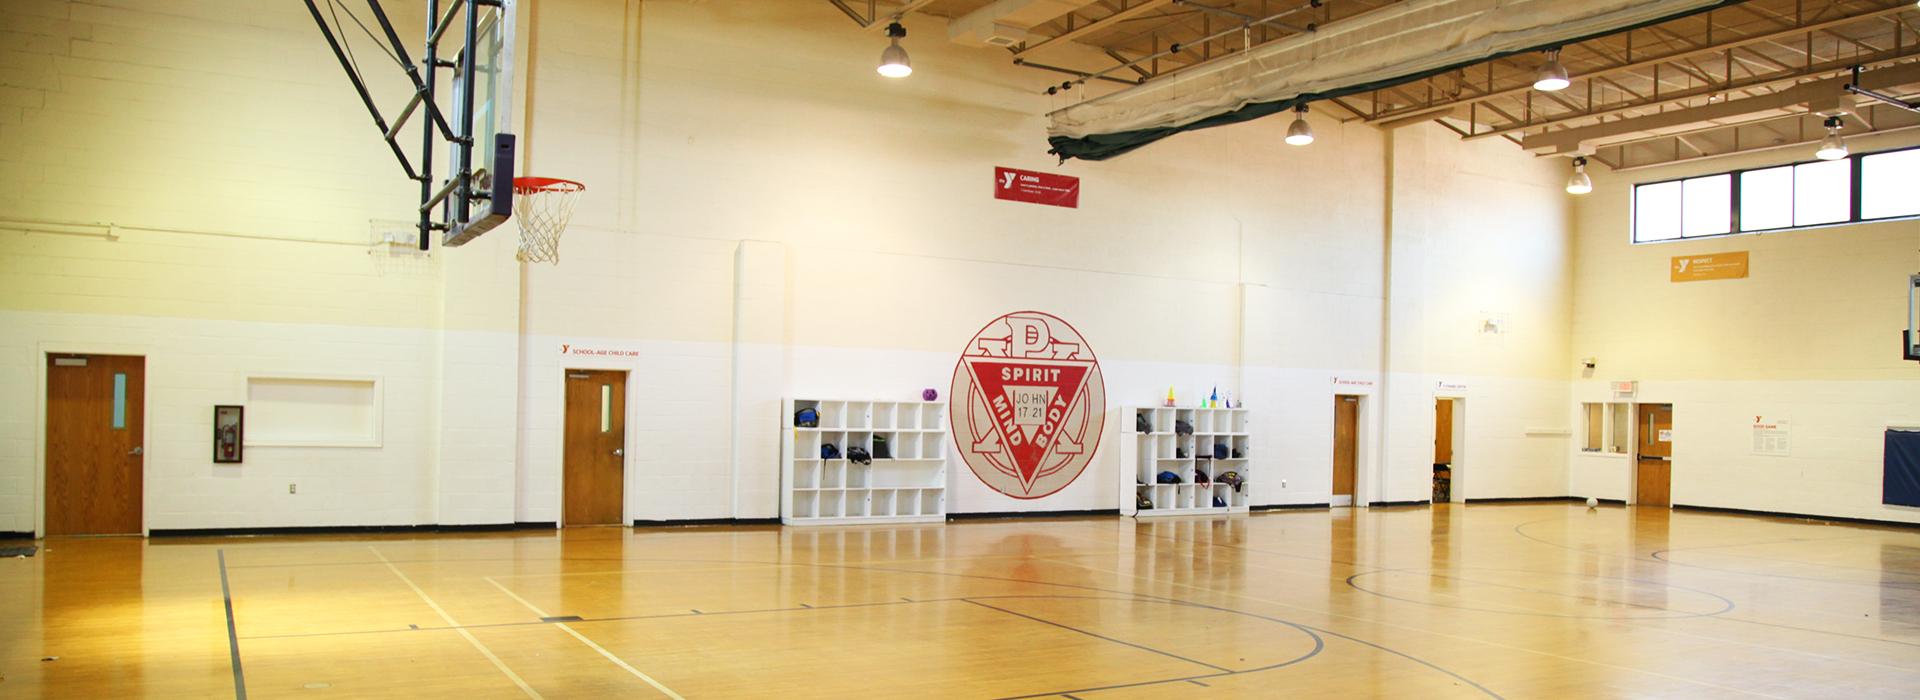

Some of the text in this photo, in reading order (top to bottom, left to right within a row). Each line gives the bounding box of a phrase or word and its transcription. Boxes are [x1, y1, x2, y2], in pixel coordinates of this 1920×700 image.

[573, 348, 607, 356] SCHOOL-AGE
[1001, 367, 1061, 382] SPIRIT
[993, 394, 1022, 446] MIND
[1018, 407, 1042, 418] 17 21
[1035, 394, 1067, 449] BODY
